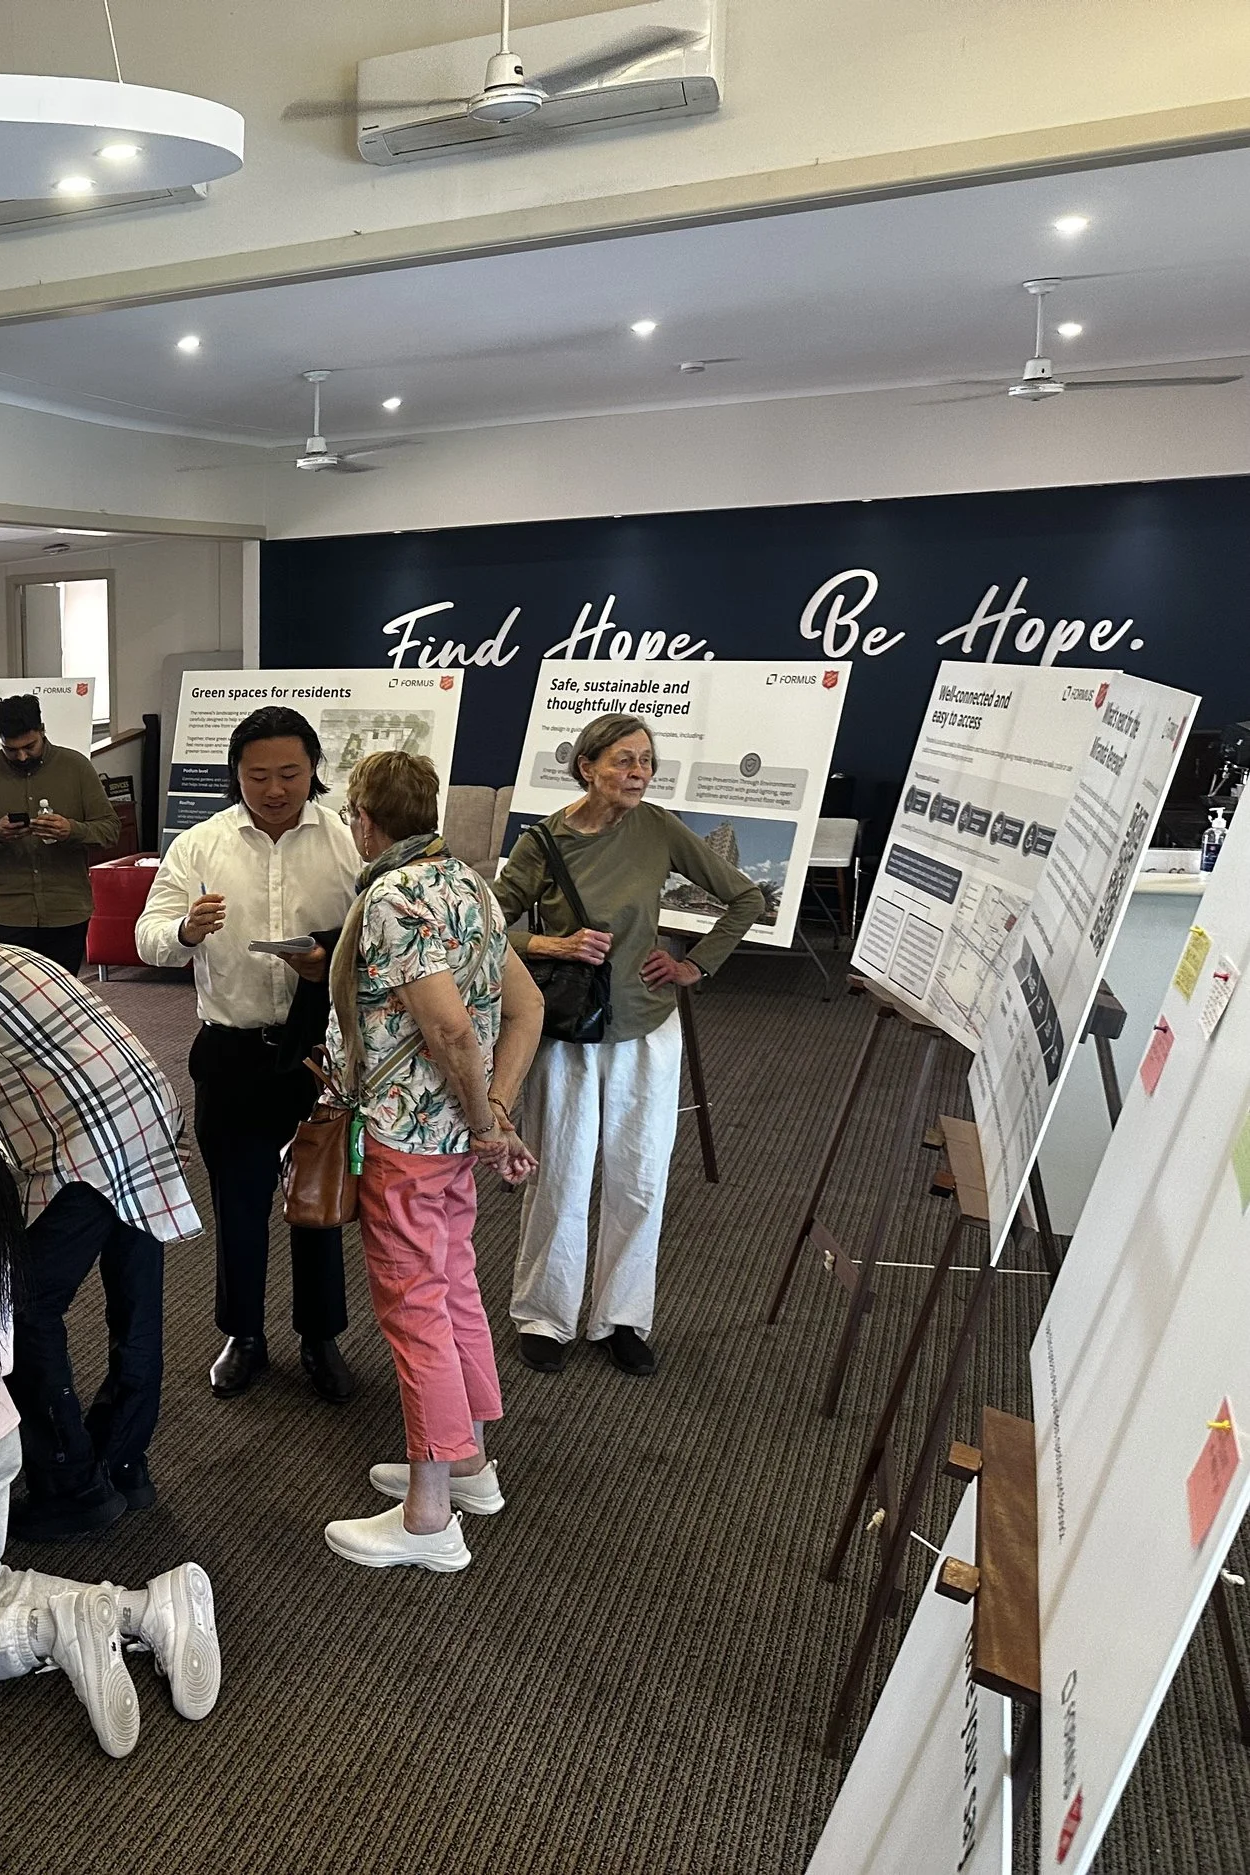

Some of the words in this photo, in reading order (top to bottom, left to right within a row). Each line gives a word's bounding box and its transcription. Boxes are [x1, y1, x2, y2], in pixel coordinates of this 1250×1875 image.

[382, 600, 520, 668] Find
[544, 595, 715, 661] Hope.
[799, 568, 907, 658] Be
[935, 576, 1145, 667] Hope.
[400, 679, 435, 687] FORMUS
[550, 678, 580, 693] Safe,
[584, 679, 659, 693] sustainable
[663, 680, 690, 694] and
[779, 675, 816, 685] FORMUS
[192, 687, 225, 698] Green
[228, 688, 267, 702] spaces
[271, 686, 289, 698] for
[292, 687, 352, 698] residents
[938, 685, 996, 708] Well-connected
[994, 691, 1013, 709] and
[546, 697, 627, 714] thoughtfully
[629, 699, 691, 717] designed
[931, 710, 950, 729] easy
[949, 712, 958, 725] to
[957, 713, 983, 730] access
[957, 1787, 977, 1873] say
